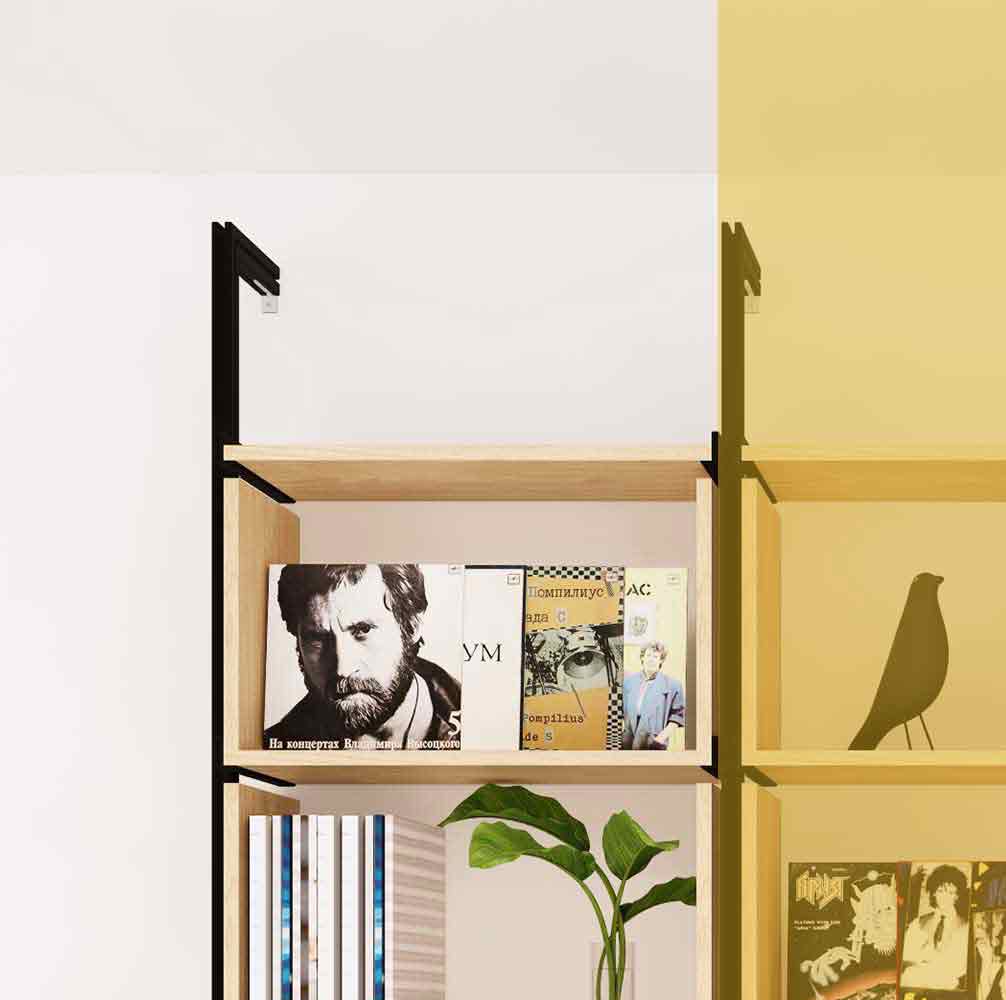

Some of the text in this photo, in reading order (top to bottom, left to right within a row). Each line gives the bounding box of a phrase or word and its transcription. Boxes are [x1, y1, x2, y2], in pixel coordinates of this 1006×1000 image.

[528, 586, 604, 600] Помпилиус
[447, 711, 461, 738] 5
[269, 738, 283, 749] На
[286, 739, 340, 750] концертах
